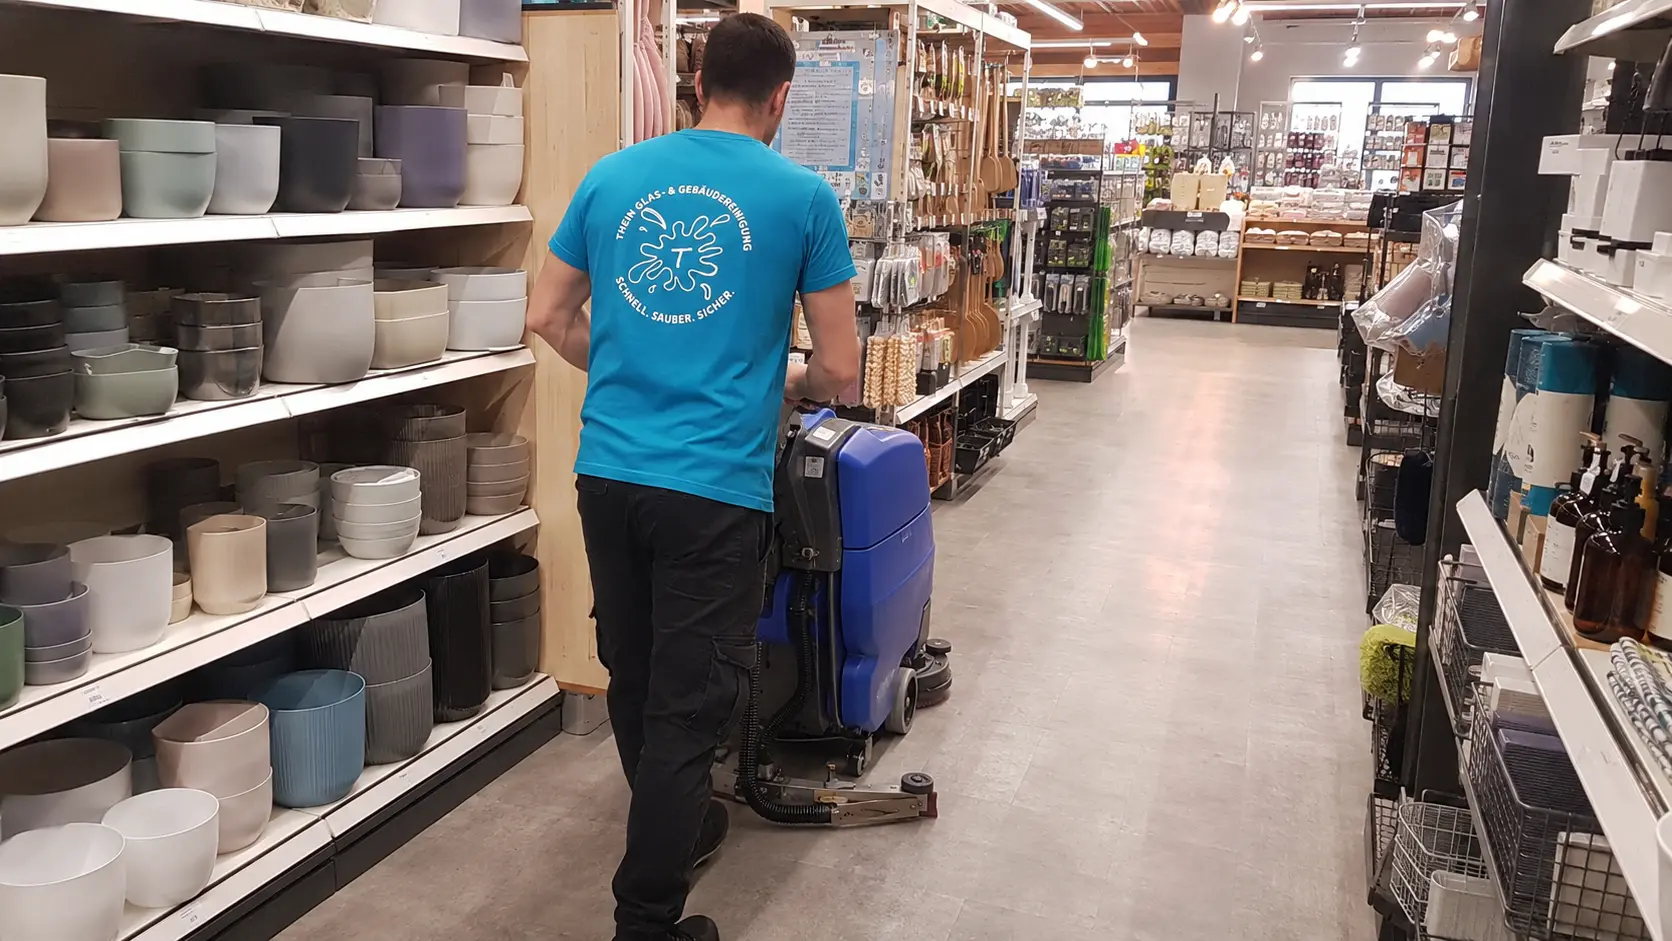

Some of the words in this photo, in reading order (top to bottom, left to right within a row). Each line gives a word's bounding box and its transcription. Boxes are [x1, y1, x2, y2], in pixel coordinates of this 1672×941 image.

[616, 209, 636, 240] THEIN
[635, 190, 666, 210] GLAS-
[667, 186, 676, 195] &
[678, 185, 752, 252] GEBÄUDEREINIGUNG
[671, 247, 693, 269] T
[615, 276, 649, 318] SCHNELL.
[651, 311, 695, 324] SAUBER.
[696, 290, 735, 320] SICHER.
